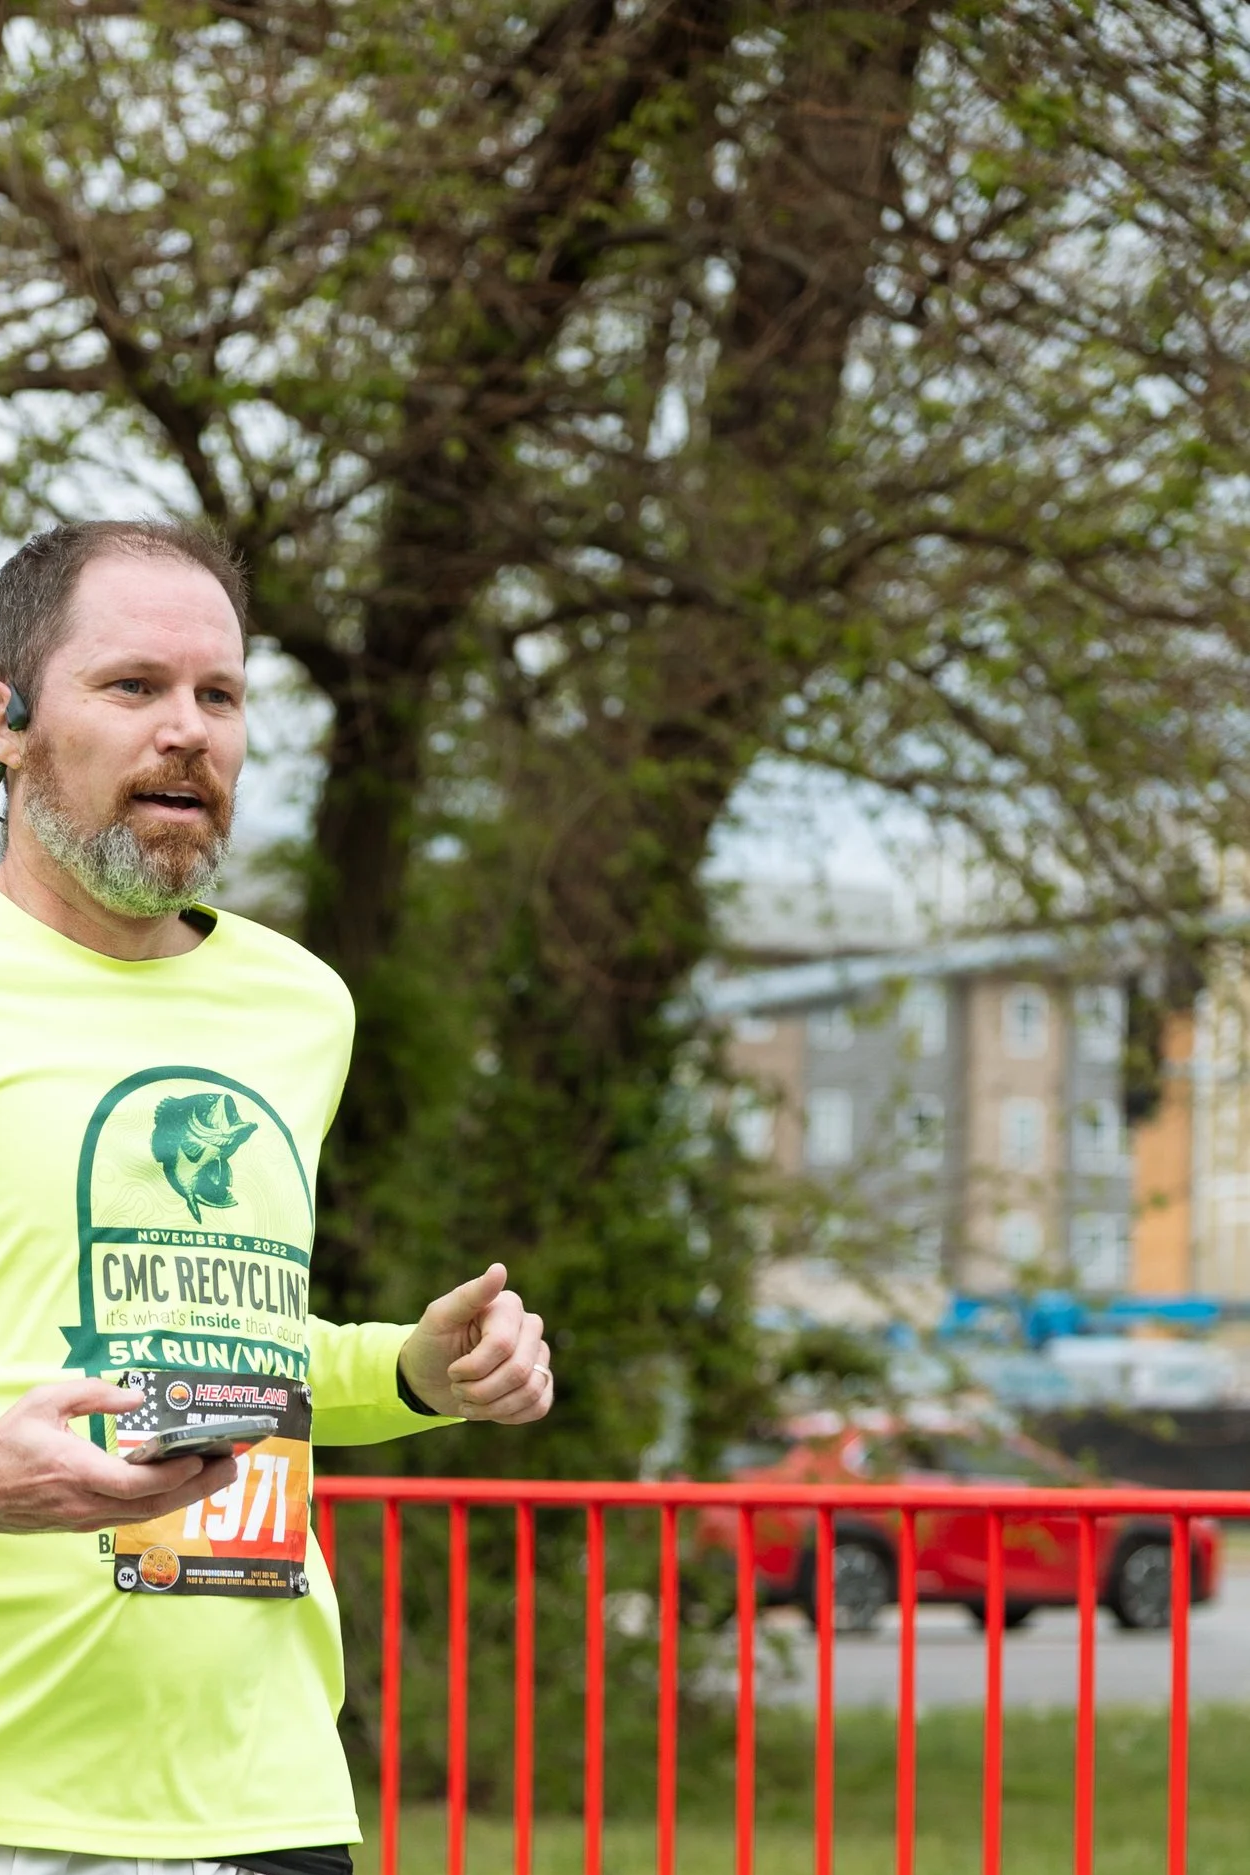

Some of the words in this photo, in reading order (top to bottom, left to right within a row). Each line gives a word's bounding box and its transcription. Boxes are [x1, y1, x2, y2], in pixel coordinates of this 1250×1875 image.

[137, 1230, 227, 1246] NOVEMBER
[233, 1239, 247, 1250] 6,
[253, 1239, 288, 1256] 2022
[102, 1253, 170, 1302] CMC
[106, 1309, 128, 1327] it's
[134, 1309, 186, 1326] what's
[190, 1310, 241, 1330] inside
[245, 1316, 274, 1336] that
[108, 1335, 158, 1366] 5K
[130, 1375, 142, 1387] 5K
[195, 1384, 288, 1406] HEARTLAND
[120, 1572, 135, 1583] 5K
